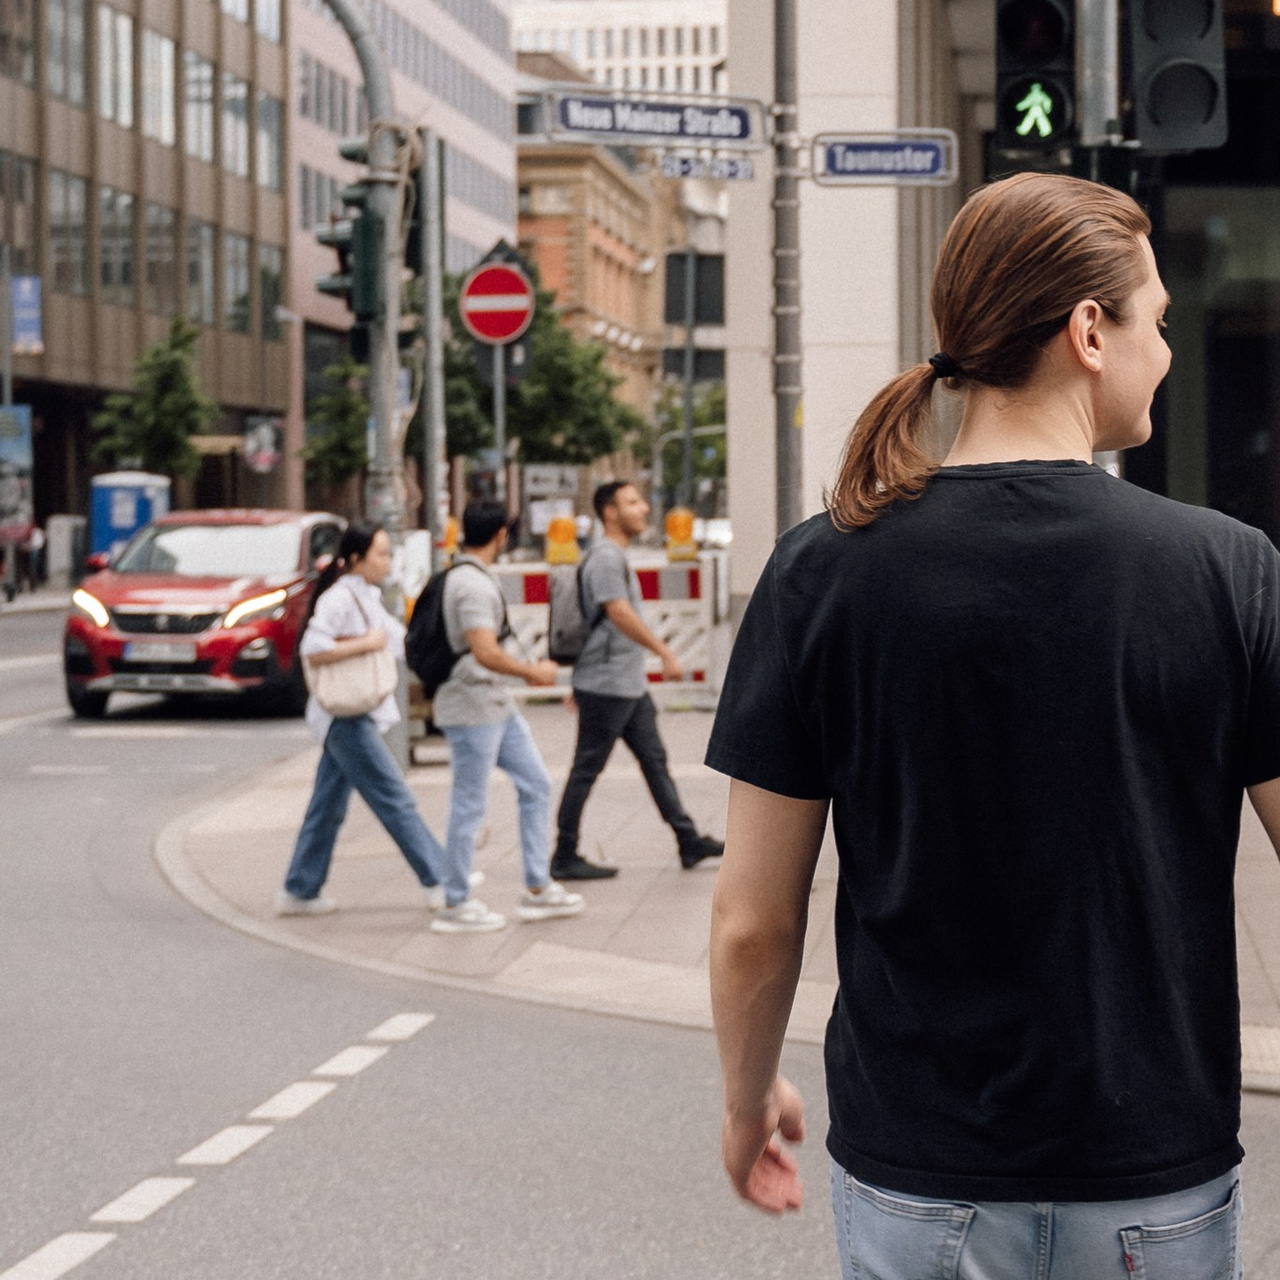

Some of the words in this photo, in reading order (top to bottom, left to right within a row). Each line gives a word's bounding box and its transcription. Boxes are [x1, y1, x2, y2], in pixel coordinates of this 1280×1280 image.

[567, 99, 613, 130] Neue
[614, 102, 681, 134] Mainzer
[683, 106, 742, 137] Straße
[832, 145, 936, 171] Taunustor
